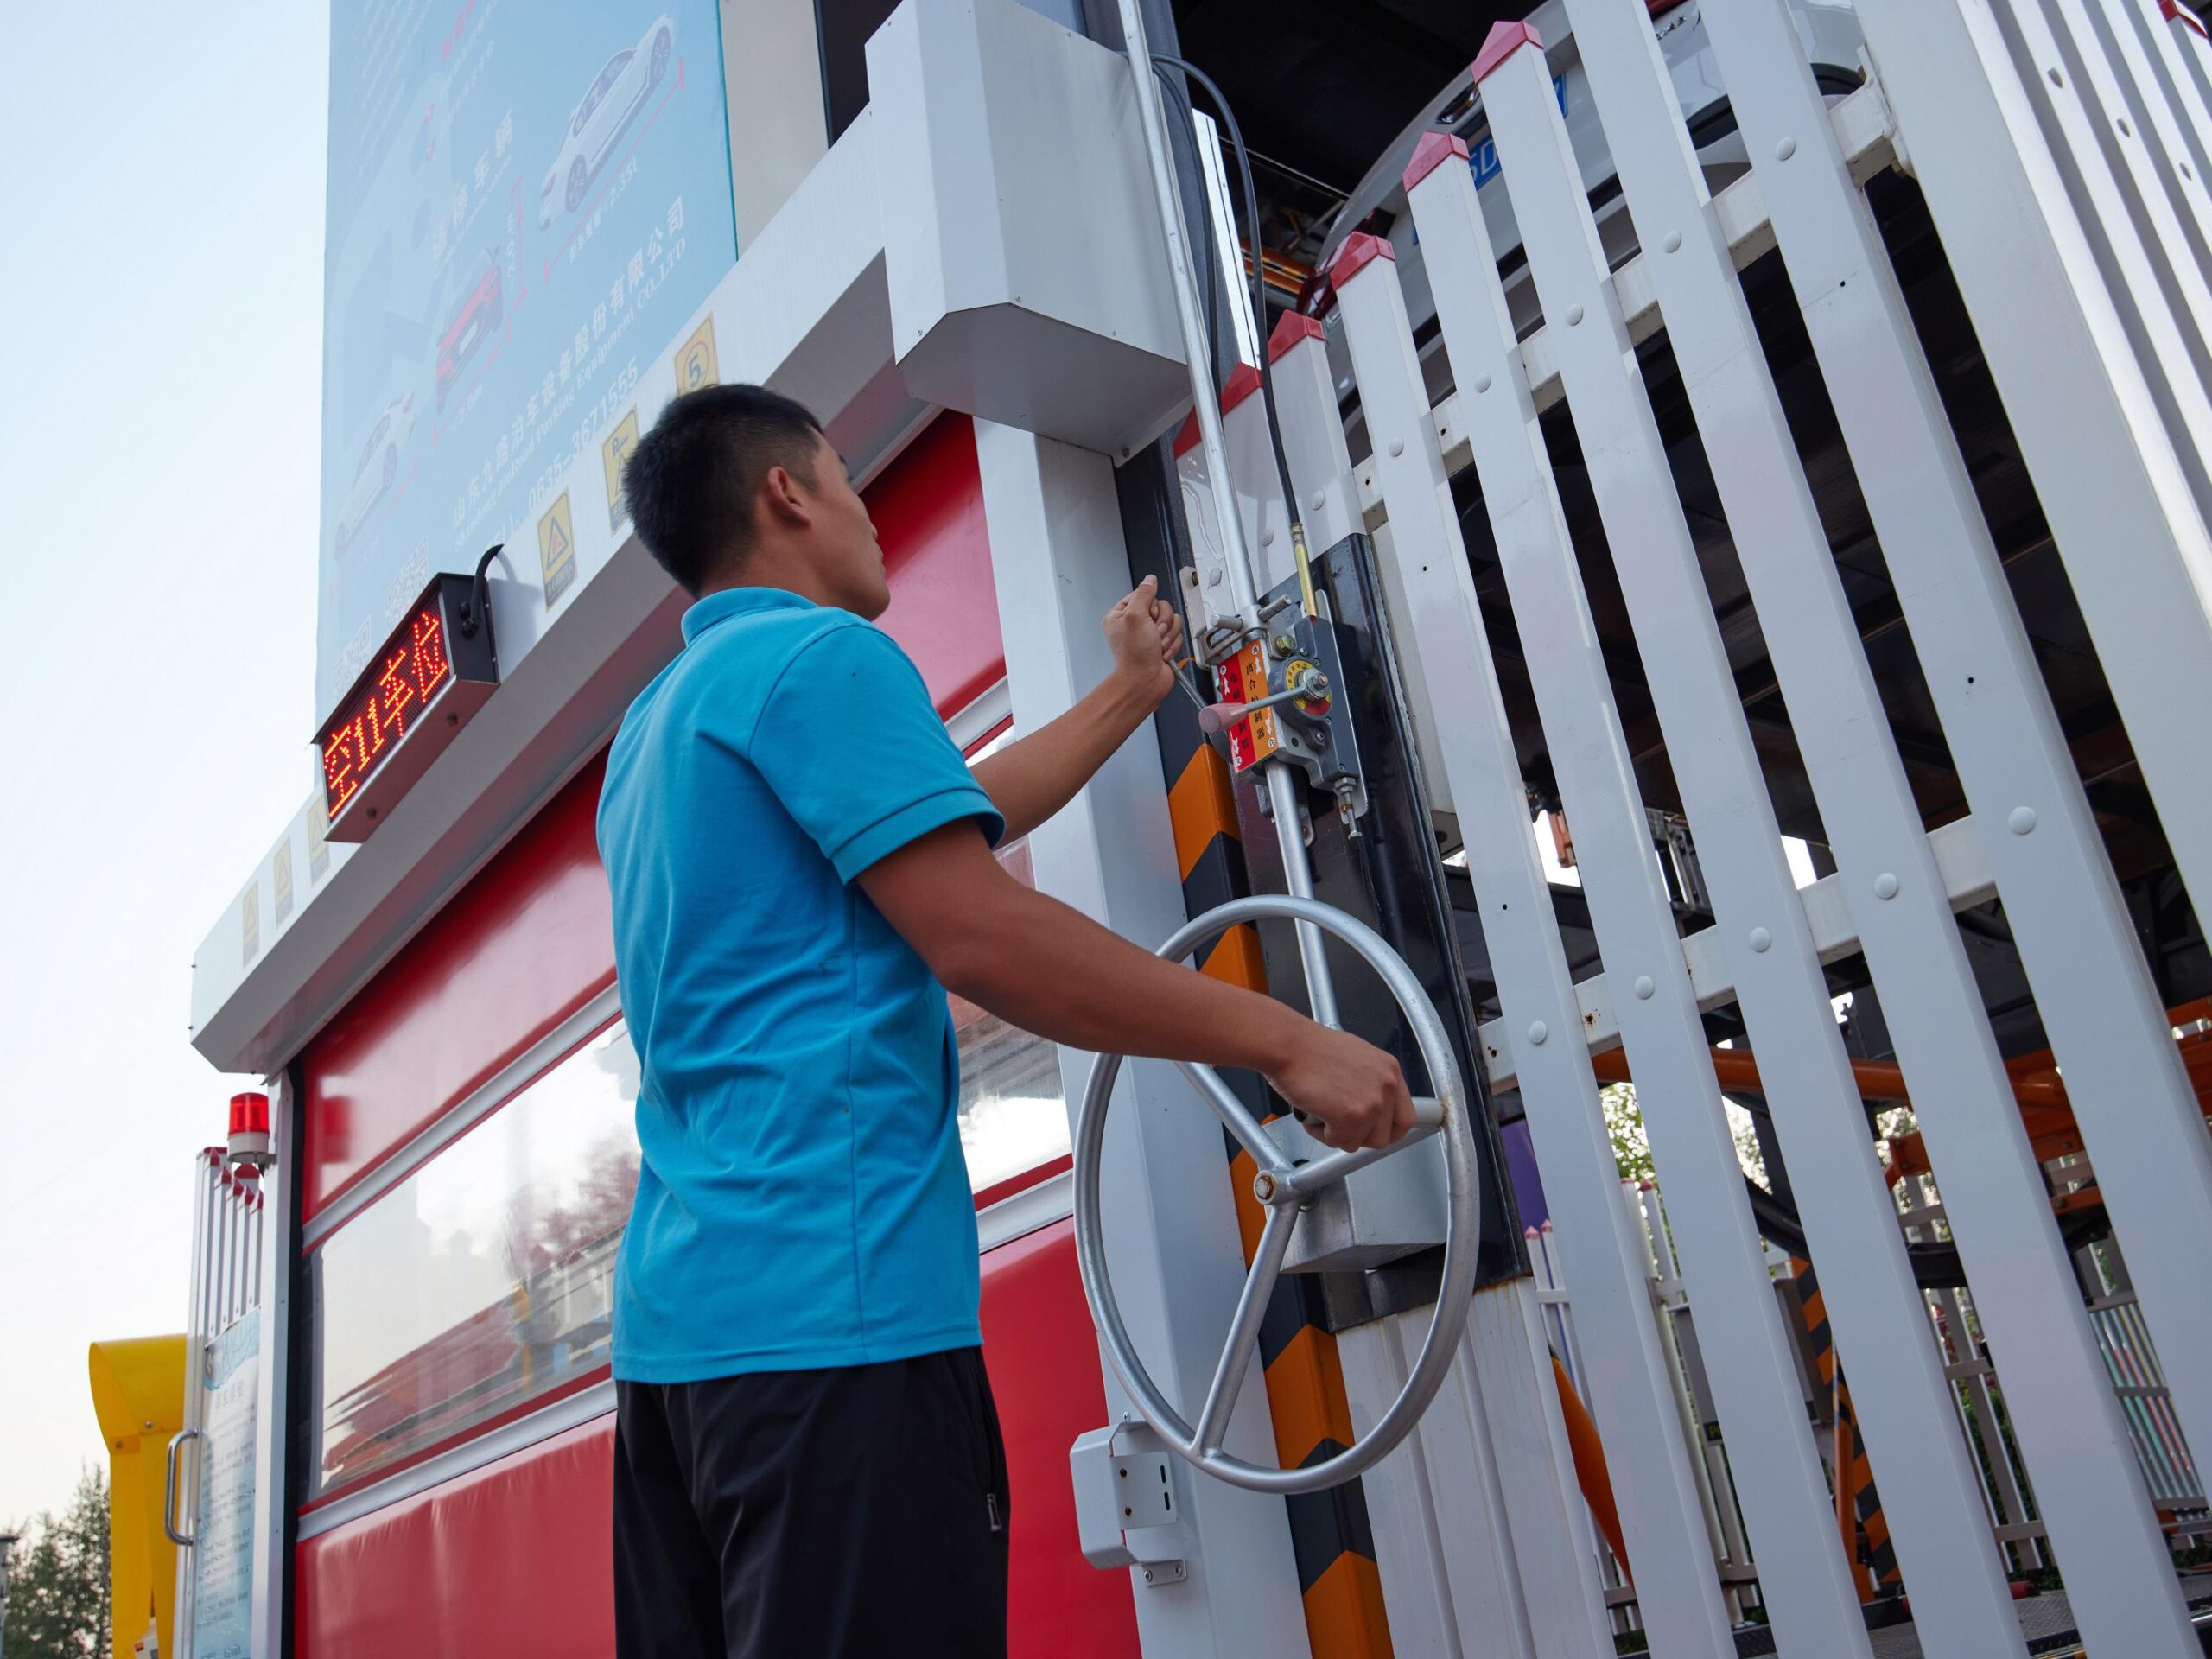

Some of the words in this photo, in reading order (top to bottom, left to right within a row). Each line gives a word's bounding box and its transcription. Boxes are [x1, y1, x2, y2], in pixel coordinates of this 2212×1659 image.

[528, 356, 638, 514] 0635-3671555
[536, 385, 575, 444] Parking
[576, 304, 635, 391] Equipment
[689, 352, 701, 388] 5
[323, 610, 448, 818] 空11车位
